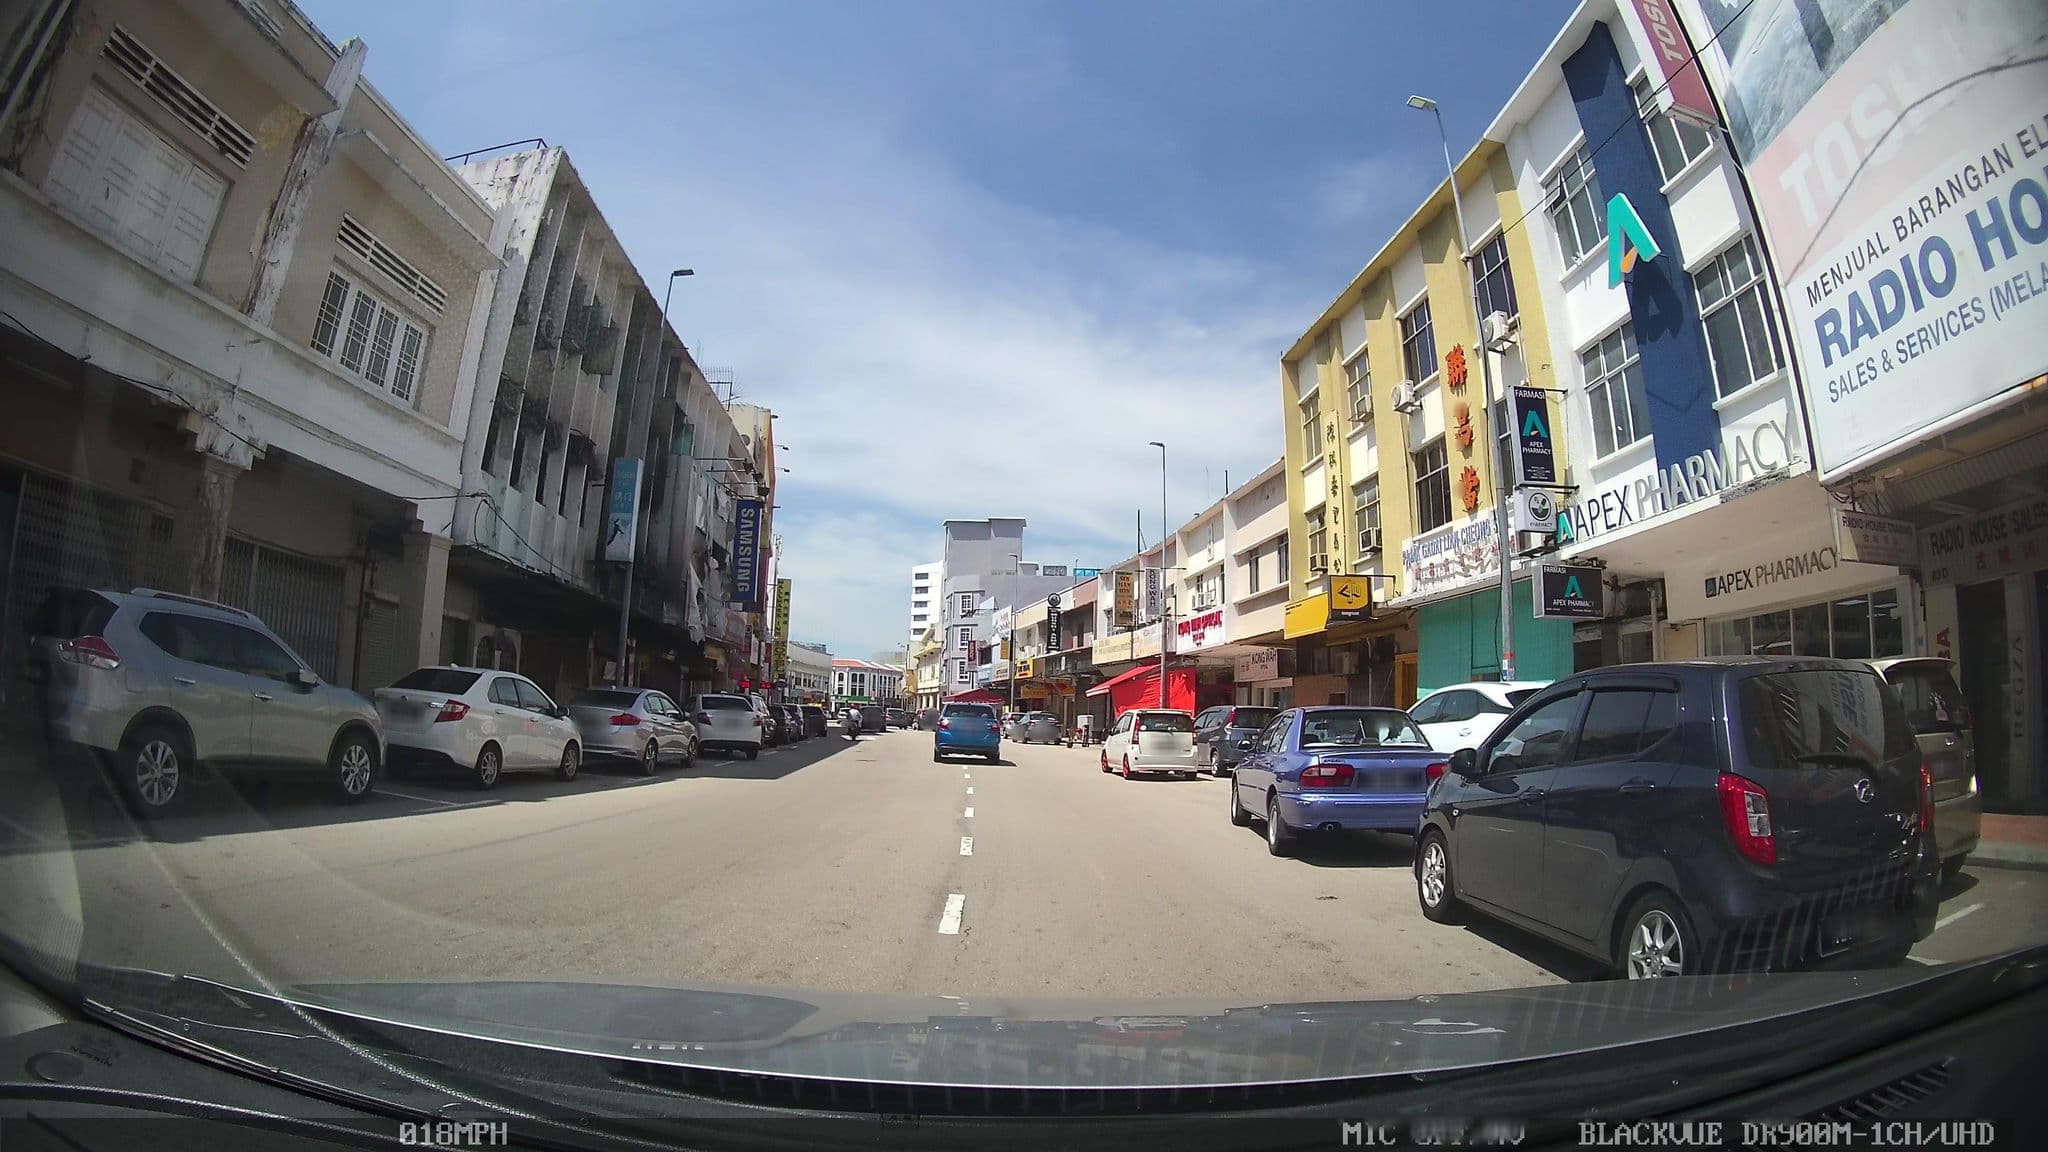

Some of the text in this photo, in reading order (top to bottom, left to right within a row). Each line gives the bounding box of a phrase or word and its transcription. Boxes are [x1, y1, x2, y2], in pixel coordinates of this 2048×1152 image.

[1806, 232, 1890, 308] MENJUAL
[1891, 142, 2015, 243] BARANGAN
[1814, 165, 2048, 369] RADIO HO
[1827, 354, 1878, 403] SALES
[1882, 344, 1894, 372] &
[1897, 296, 1987, 365] SERVICES
[1515, 389, 1545, 400] FARMASI
[1522, 447, 1551, 455] PHARMACY
[1575, 485, 1634, 541] APEX
[1635, 409, 1793, 519] PHARMACY
[1461, 519, 1491, 546] CHEONG
[1842, 515, 1864, 530] RADIO
[1929, 525, 1964, 557] RADIO
[1968, 513, 2008, 546] HOUSE
[737, 507, 754, 592] SAMSUNG
[1544, 566, 1567, 574] FARMASI
[1717, 548, 1839, 597] APEX PHARMACY
[1149, 590, 1157, 606] WAH
[1567, 600, 1594, 608] PHARMACY
